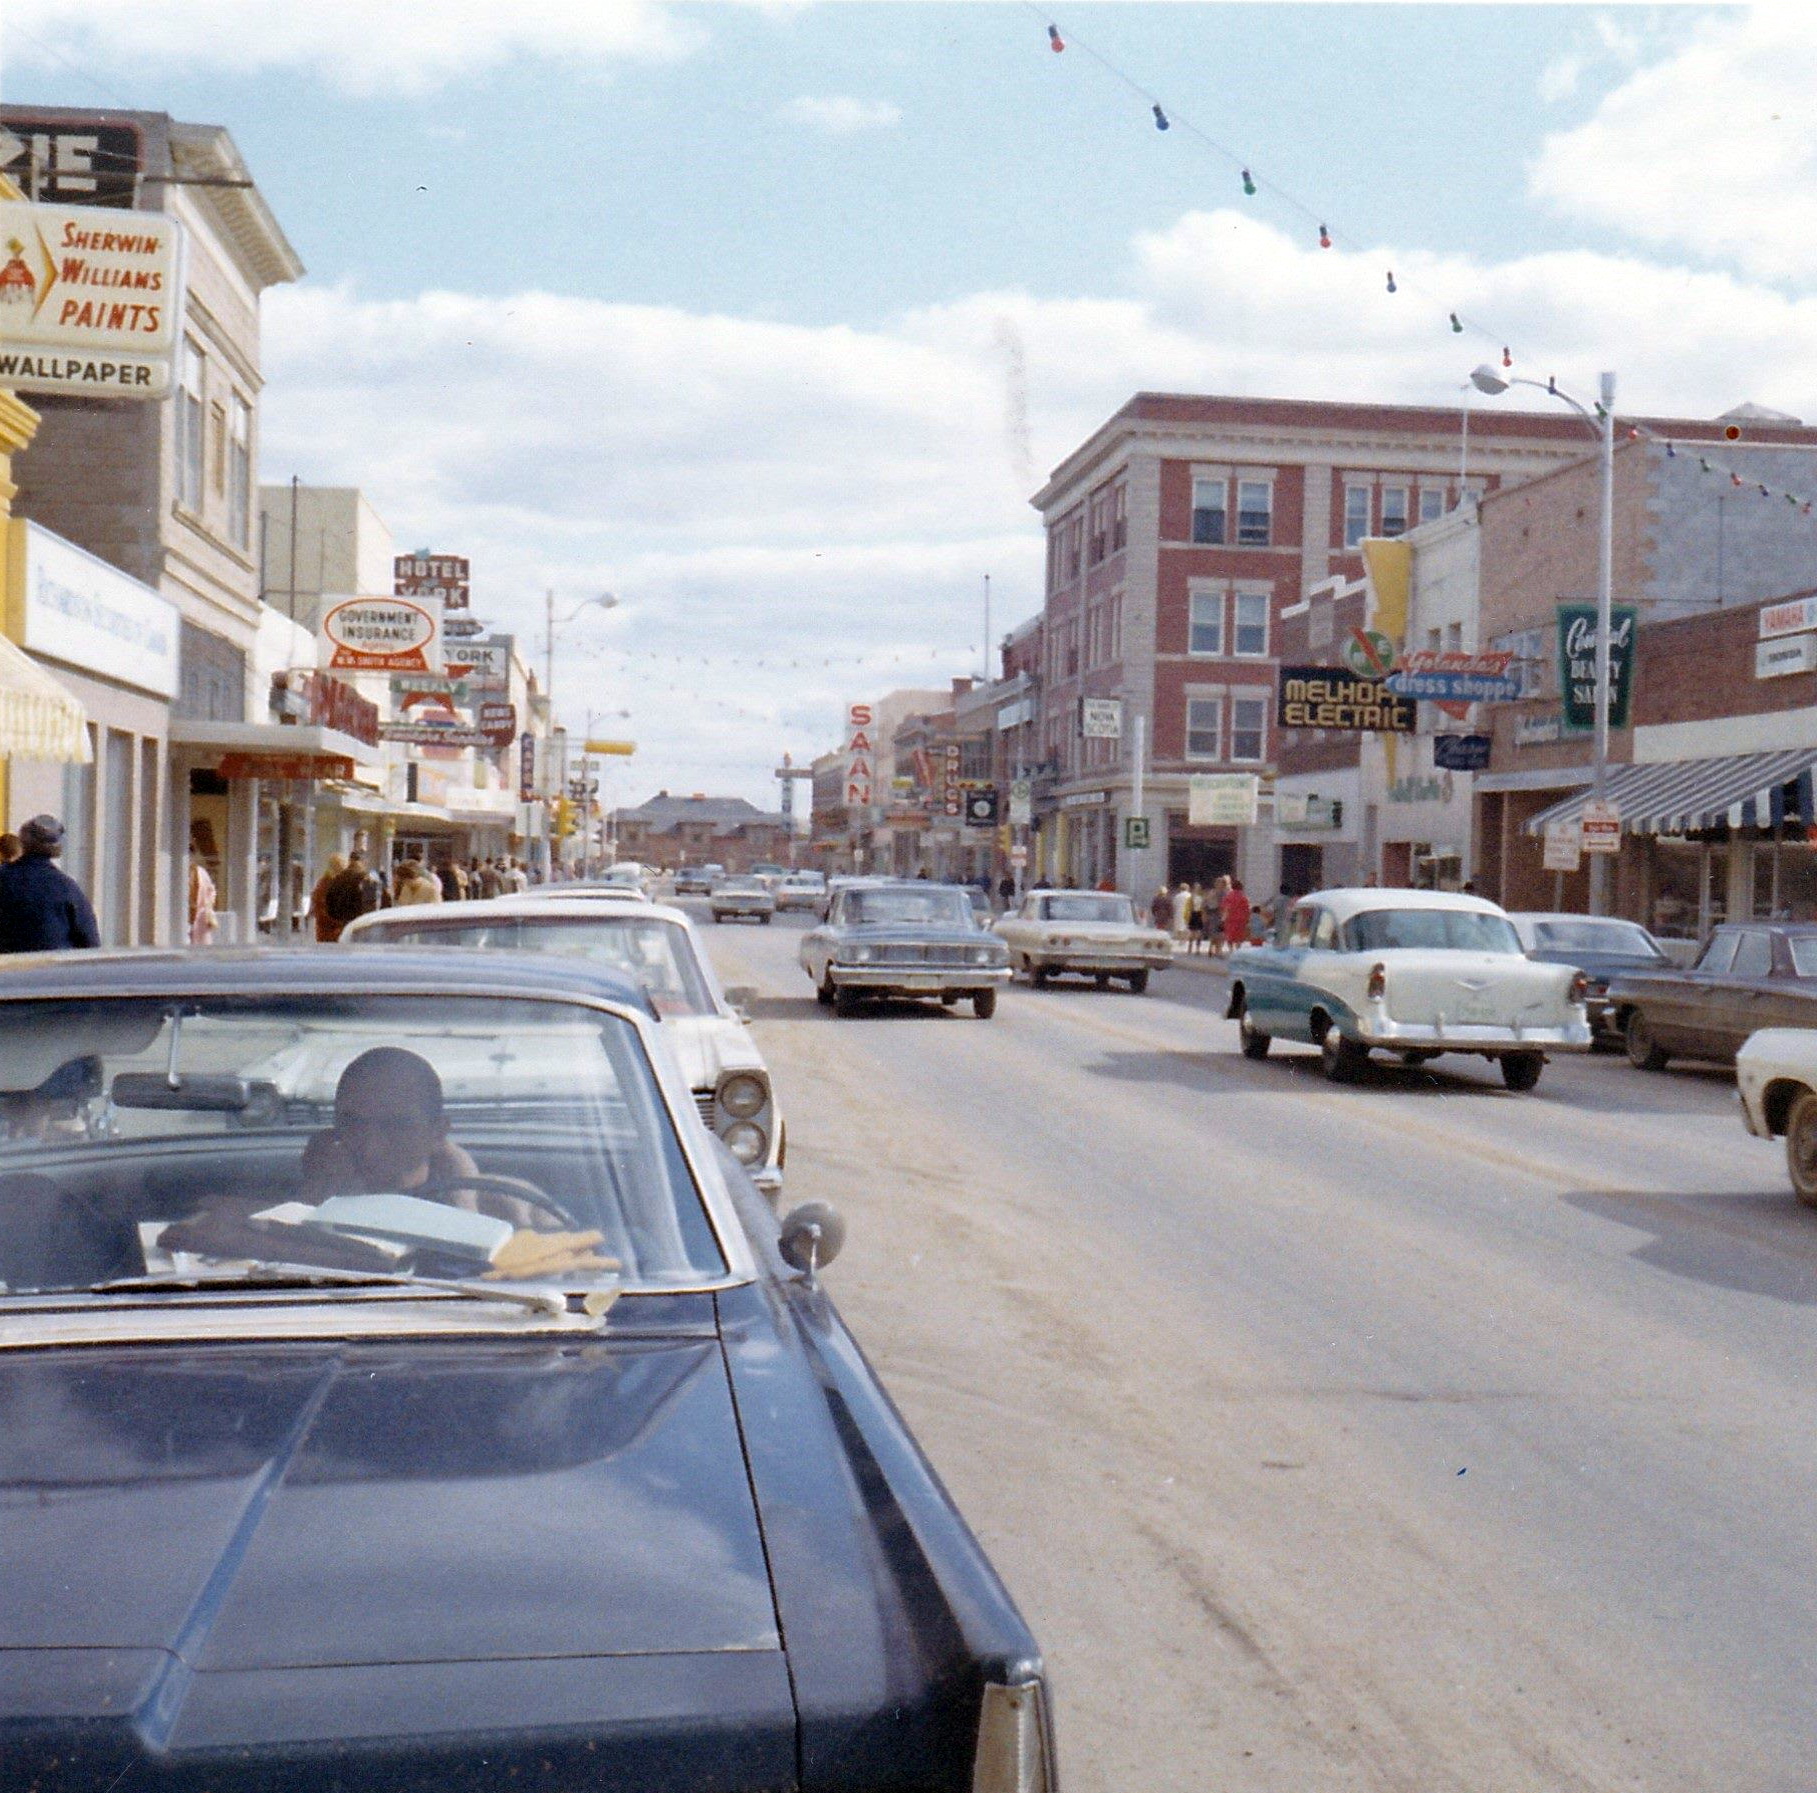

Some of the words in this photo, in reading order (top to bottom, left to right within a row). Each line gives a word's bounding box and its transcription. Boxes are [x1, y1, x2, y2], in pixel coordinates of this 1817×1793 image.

[61, 258, 162, 290] WILLIAMS
[59, 300, 161, 332] PAINTS
[0, 355, 151, 385] WALLPAPER
[400, 560, 466, 577] HOTEL
[339, 609, 418, 624] GOVERNMENT
[342, 626, 416, 641] INSURANCE
[1567, 617, 1631, 659] Cenal
[443, 649, 493, 661] YORK
[1571, 660, 1622, 679] BEAY
[1395, 670, 1447, 694] dress
[1090, 711, 1115, 722] NOVA
[1285, 702, 1408, 728] ELECTRIC
[1087, 722, 1119, 735] SCOTIA
[849, 704, 872, 804] SAAN
[945, 745, 959, 815] DRUGS
